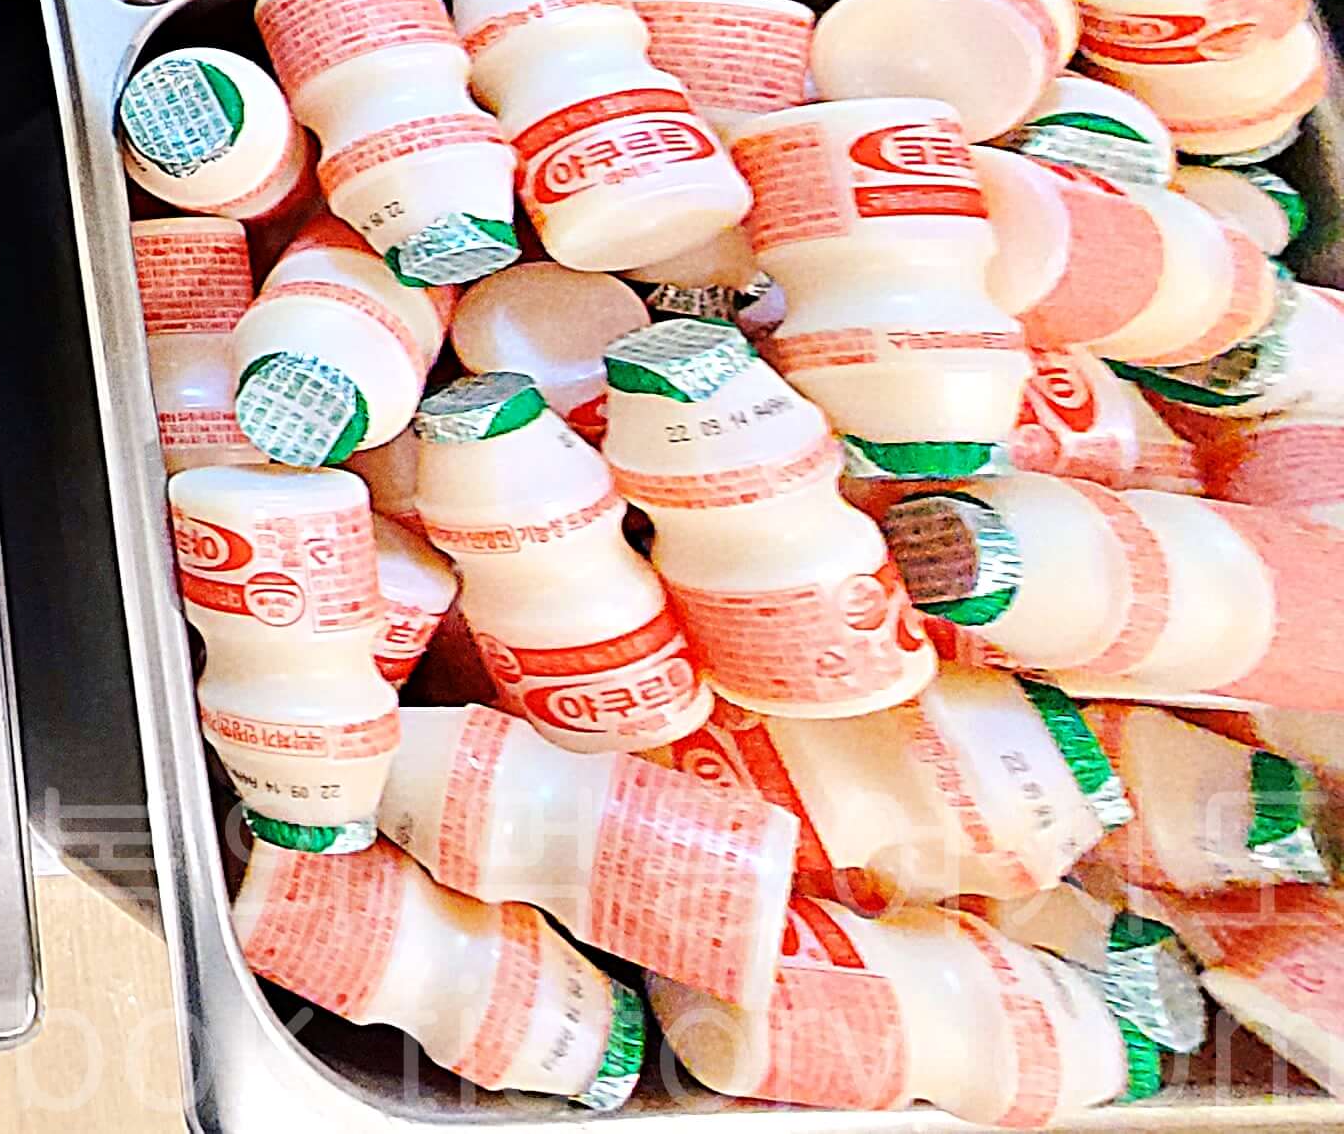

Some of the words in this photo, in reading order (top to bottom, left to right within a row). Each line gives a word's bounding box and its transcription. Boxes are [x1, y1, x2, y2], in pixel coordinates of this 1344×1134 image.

[546, 125, 695, 186] 야쿠르트
[664, 423, 691, 444] 22
[320, 784, 342, 800] 22
